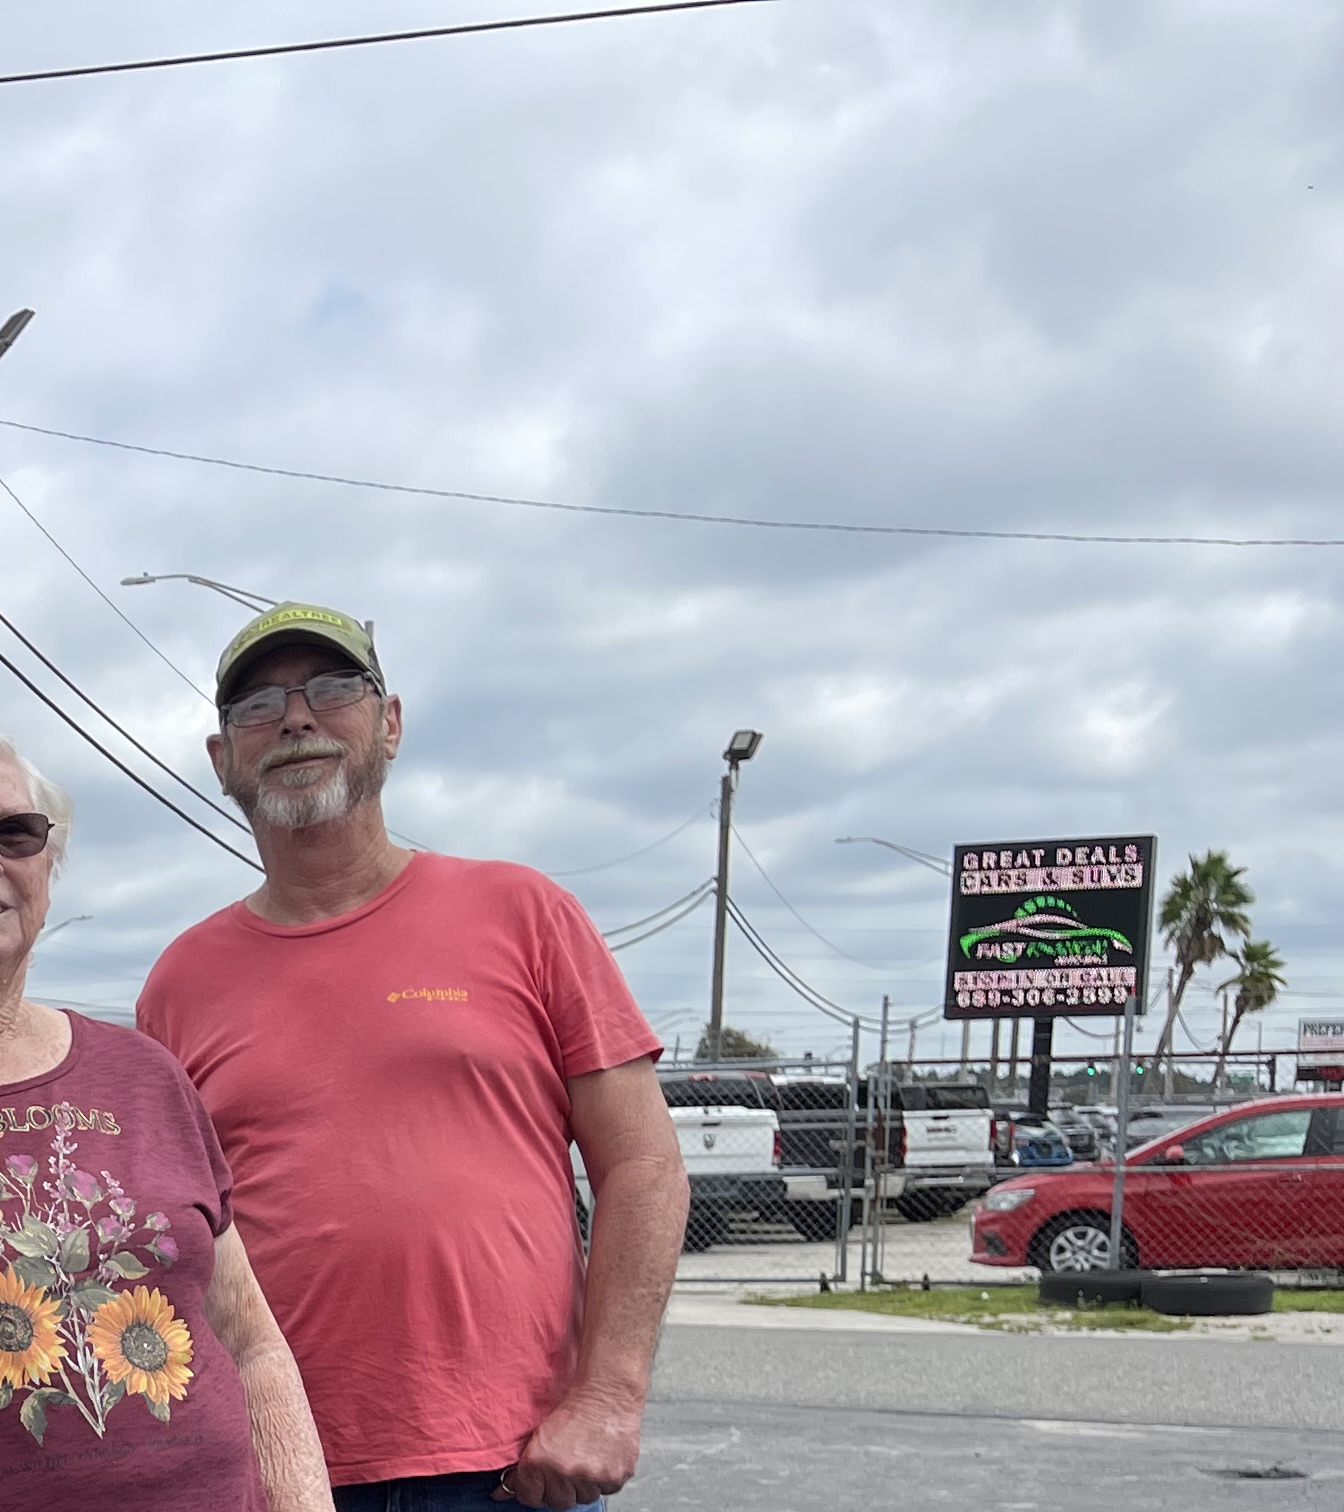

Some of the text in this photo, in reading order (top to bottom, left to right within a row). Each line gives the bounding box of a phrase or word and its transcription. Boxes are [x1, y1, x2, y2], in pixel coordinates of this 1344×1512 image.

[962, 843, 1139, 871] GREAT DEALS
[1303, 1022, 1344, 1038] PREFE
